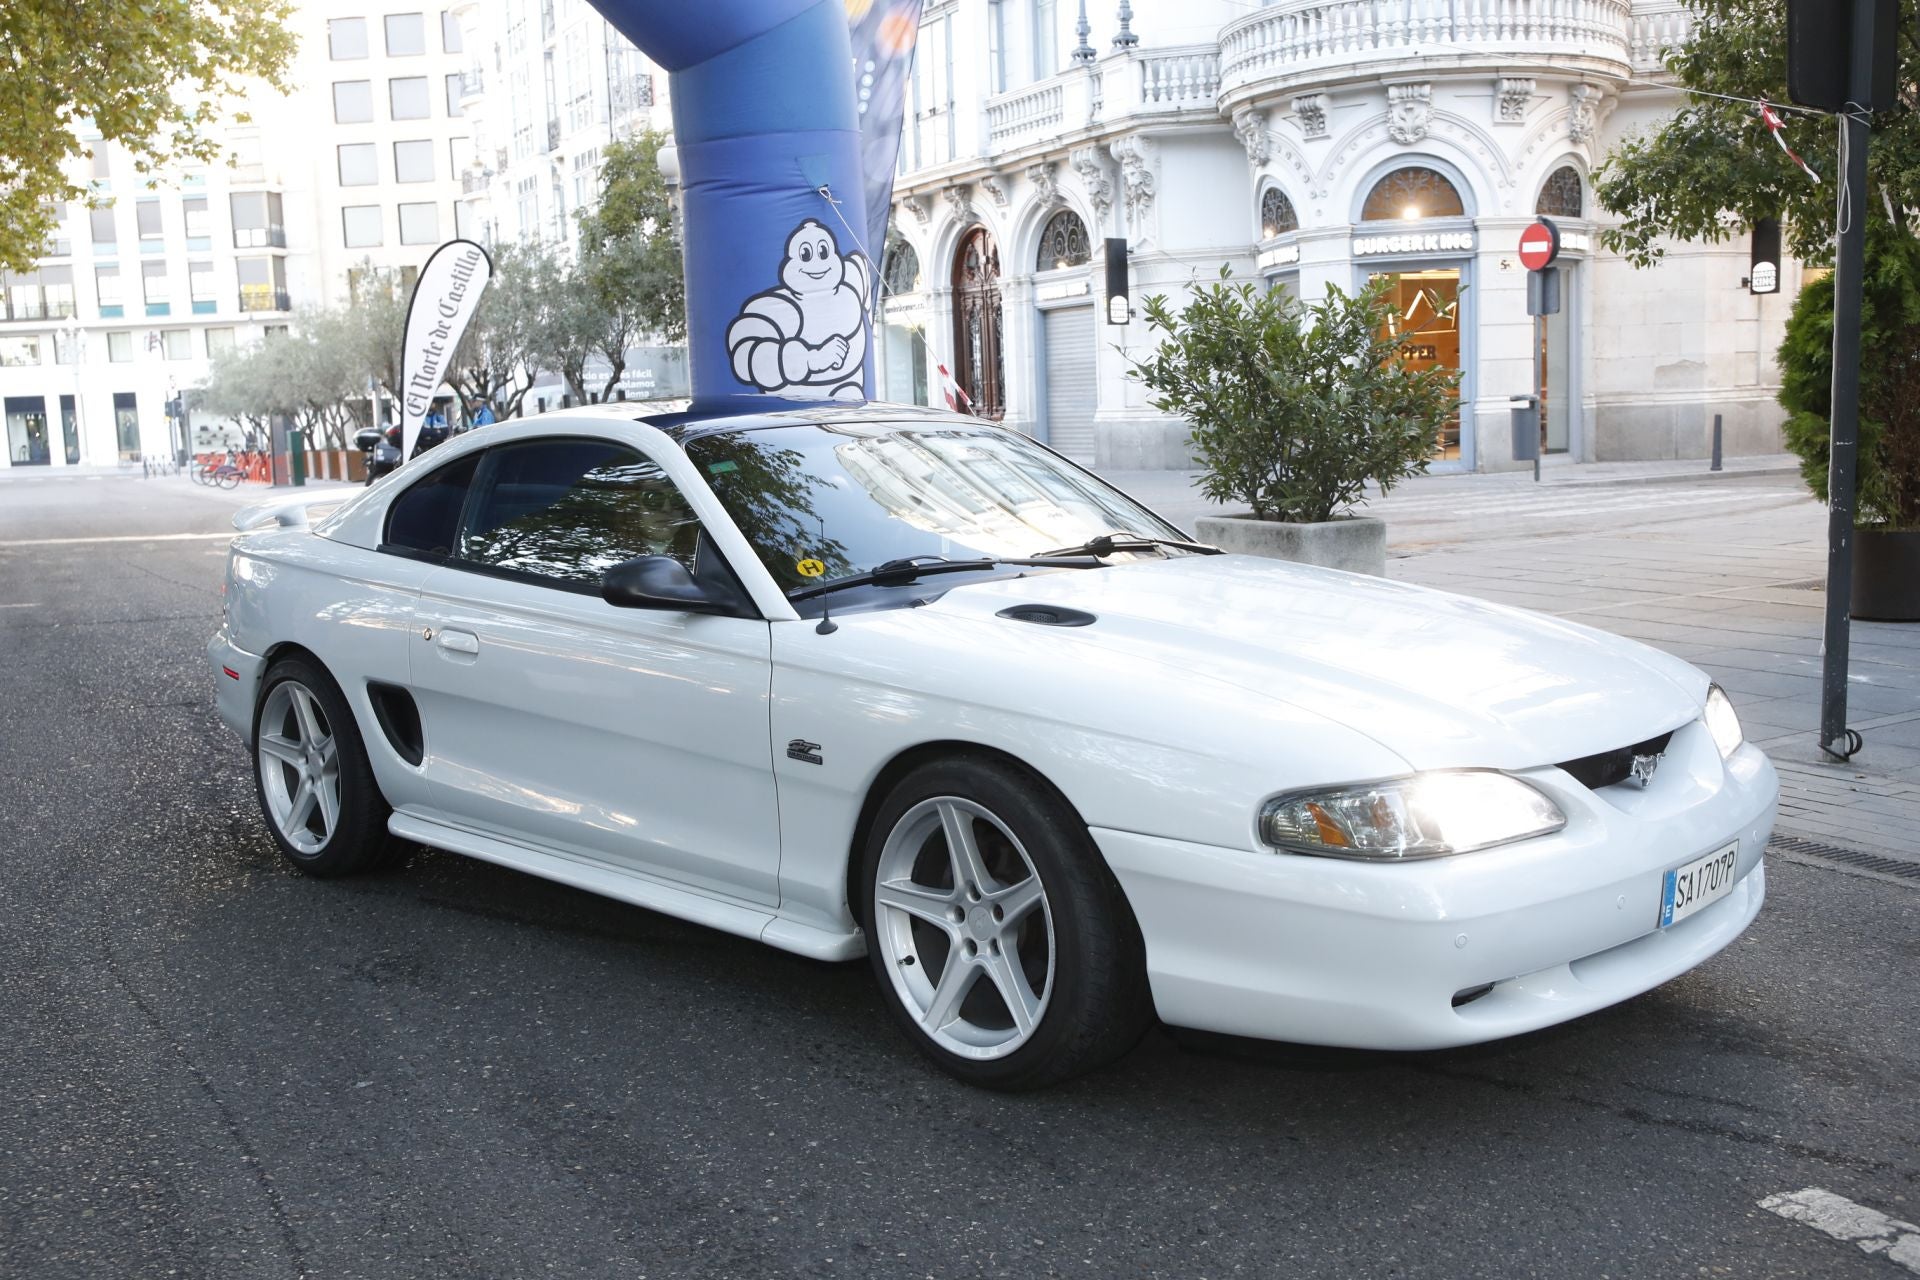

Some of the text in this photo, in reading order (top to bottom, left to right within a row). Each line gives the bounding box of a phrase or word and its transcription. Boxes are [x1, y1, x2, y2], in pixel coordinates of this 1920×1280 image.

[1353, 236, 1423, 255] BURGER
[406, 250, 481, 417] El Norte de Castilla
[632, 368, 653, 379] fácil
[802, 561, 821, 575] H
[1664, 904, 1672, 918] E
